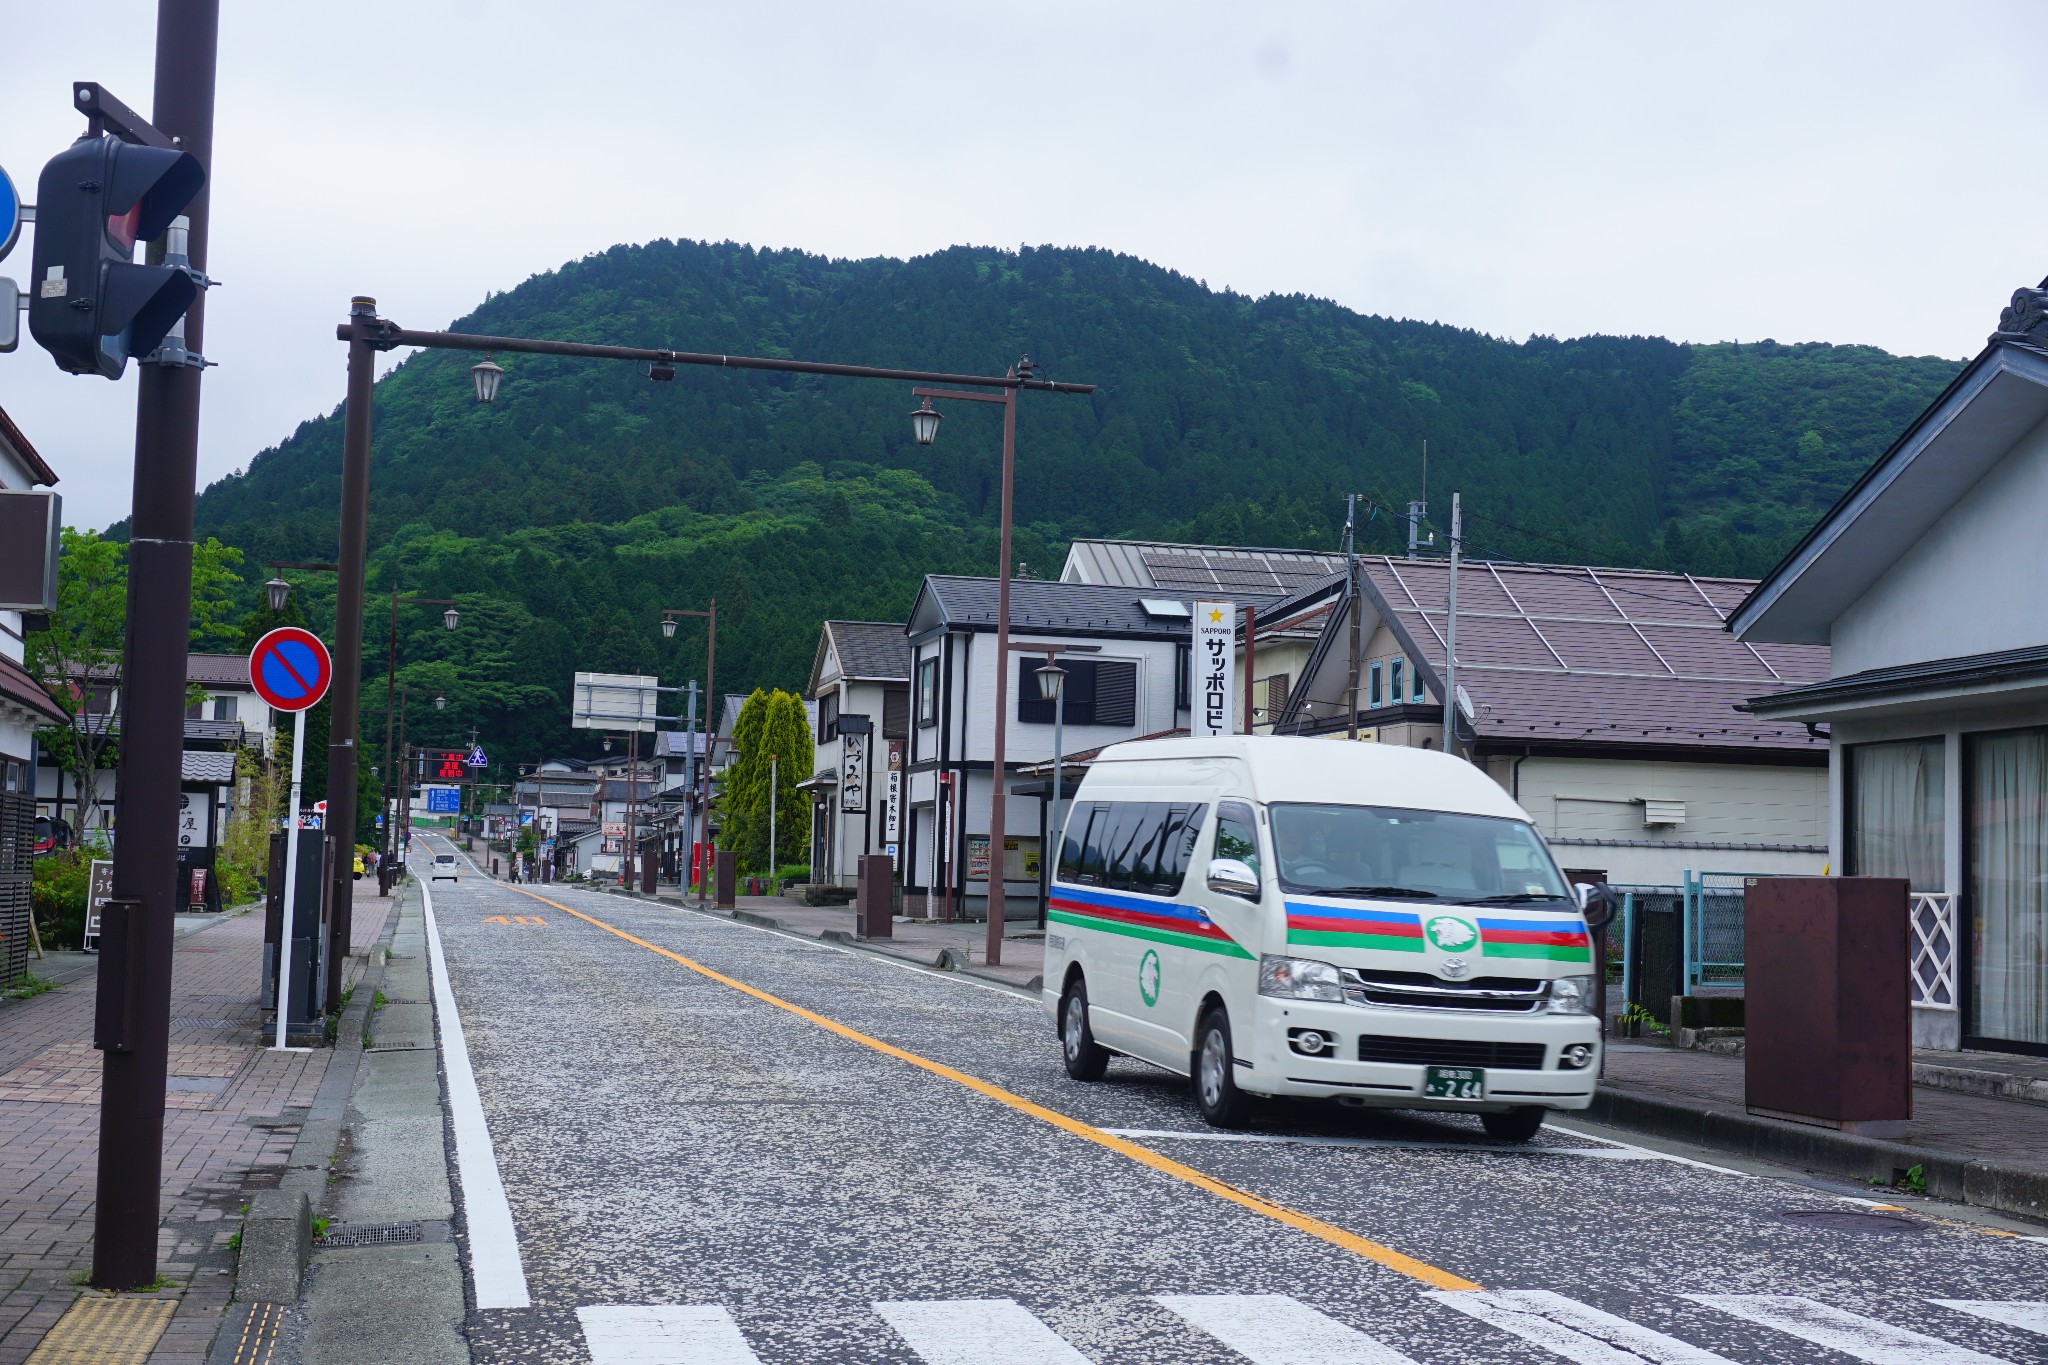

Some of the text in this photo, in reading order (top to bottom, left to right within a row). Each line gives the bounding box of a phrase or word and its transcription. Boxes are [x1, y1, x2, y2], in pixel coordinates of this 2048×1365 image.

[1200, 627, 1231, 635] SAPPORO
[845, 735, 862, 797] いづみや
[888, 772, 898, 831] 箱根寄木細工
[887, 846, 896, 856] P
[480, 915, 549, 926] 40
